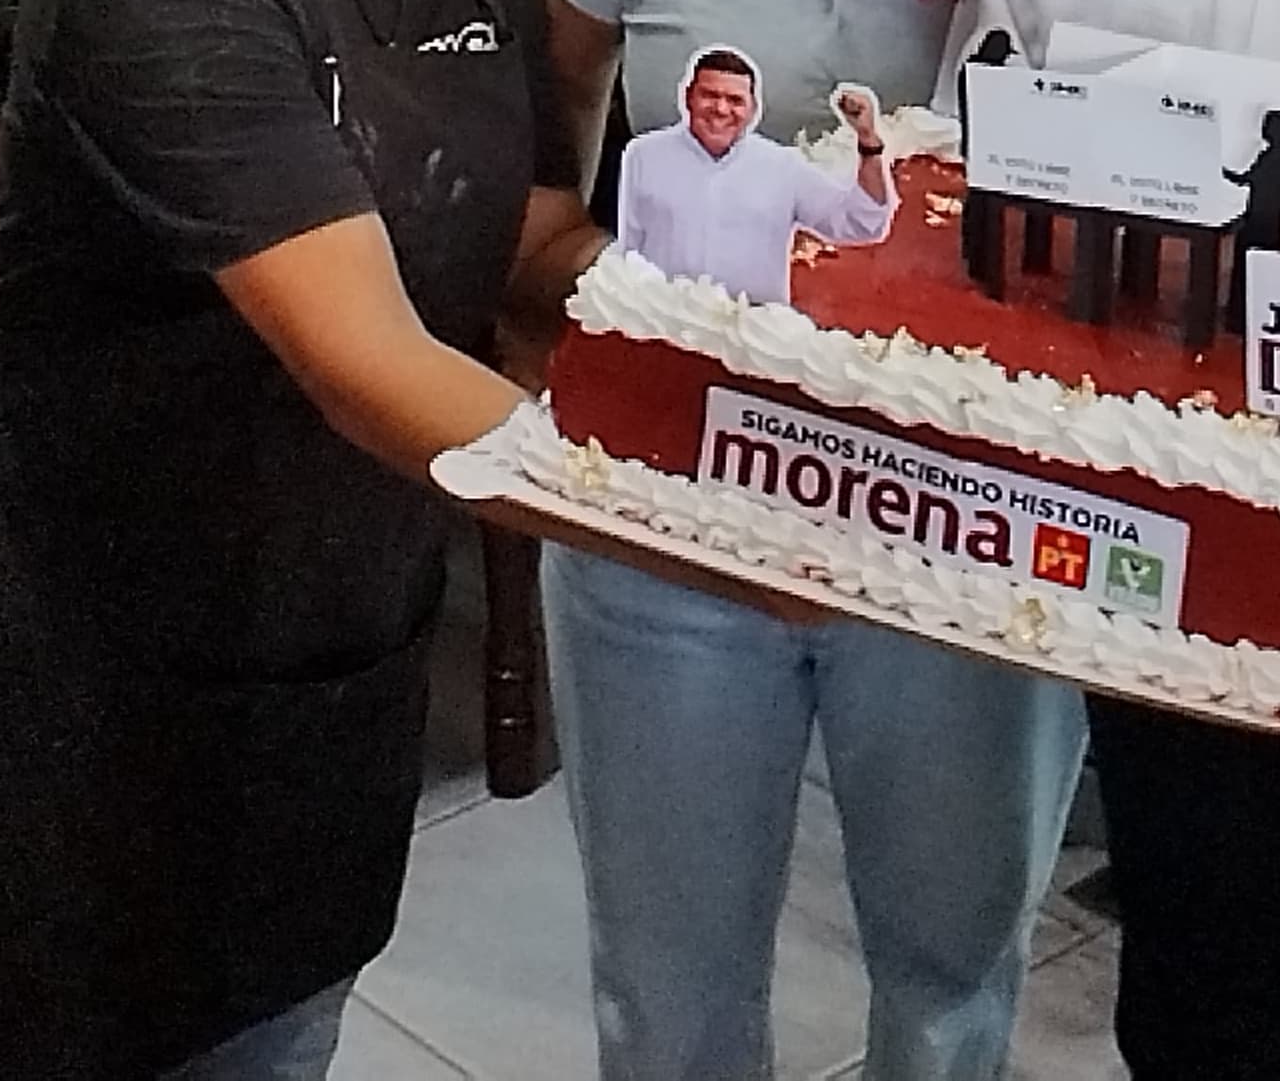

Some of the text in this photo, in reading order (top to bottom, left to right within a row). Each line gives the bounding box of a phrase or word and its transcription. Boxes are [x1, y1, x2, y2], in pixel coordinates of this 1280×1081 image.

[710, 430, 1014, 568] morena
[741, 410, 1140, 546] SIGAMOS HACIENDO HISTORIA
[1038, 545, 1084, 580] PT
